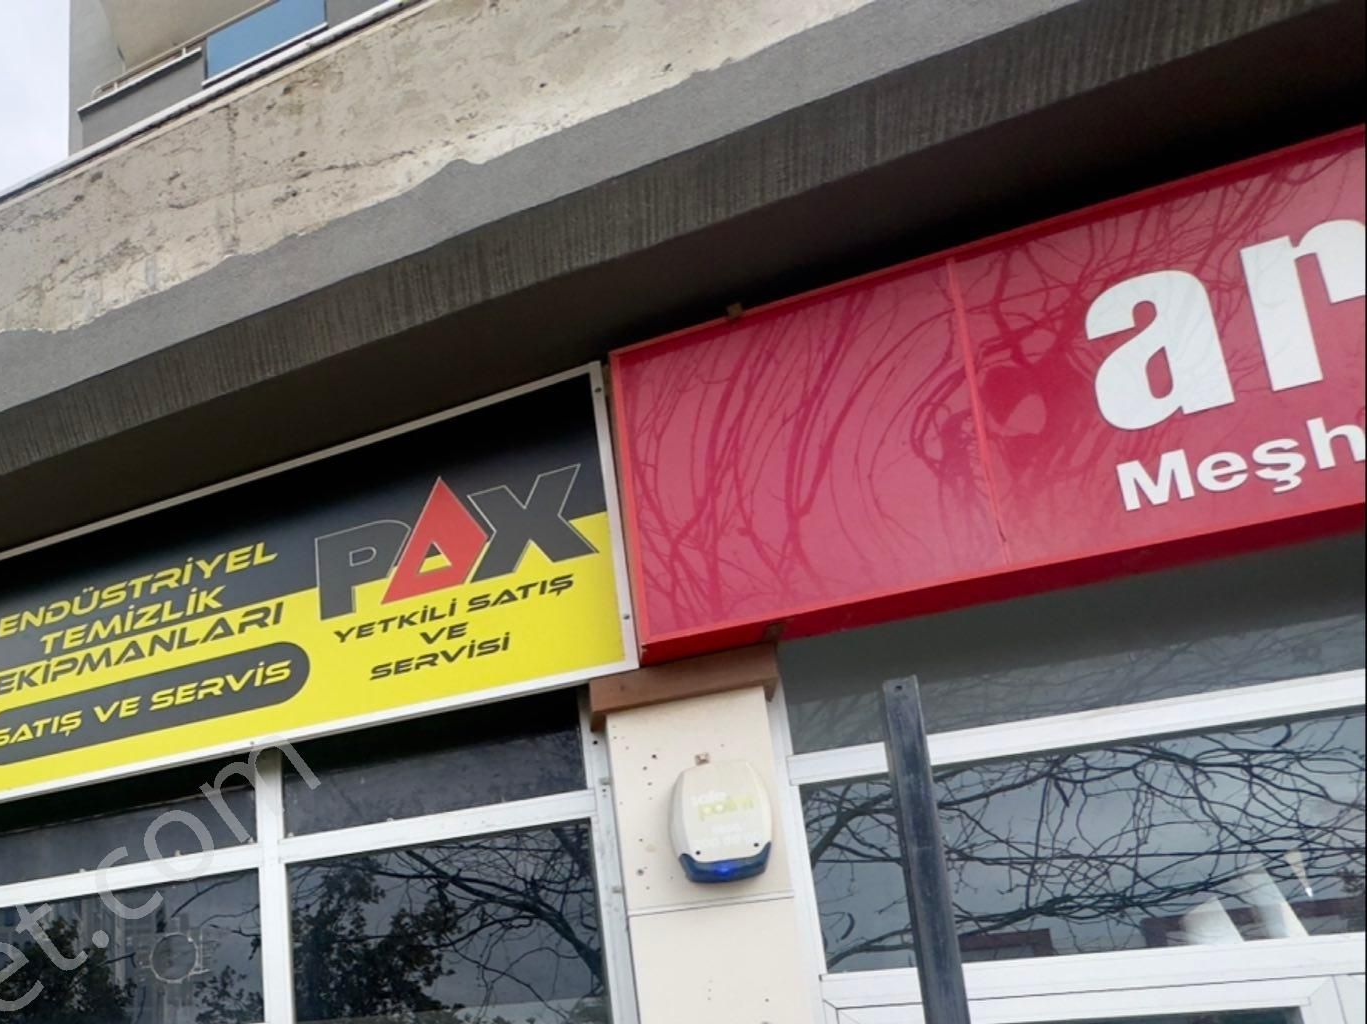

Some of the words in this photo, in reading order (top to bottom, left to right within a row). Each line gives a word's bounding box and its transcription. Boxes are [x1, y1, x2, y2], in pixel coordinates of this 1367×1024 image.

[314, 463, 600, 621] PAX
[40, 585, 226, 655] TEMİZLİK
[334, 598, 457, 643] YETKİLİ
[466, 573, 574, 613] SATIŞ
[420, 621, 468, 645] VE
[369, 632, 510, 680] SERVİSİ
[93, 695, 141, 723] VE
[149, 660, 292, 711] SERVİS
